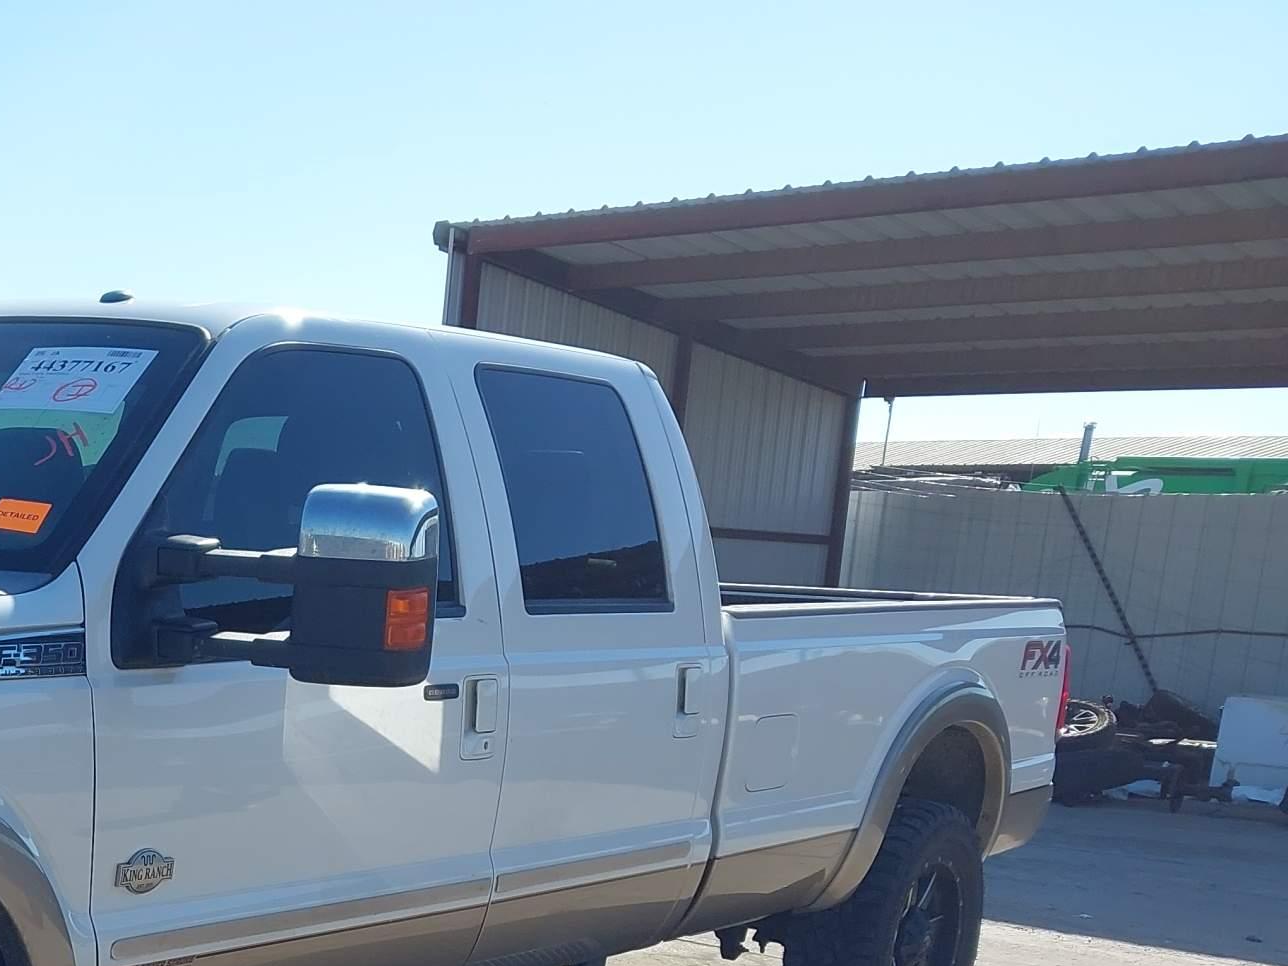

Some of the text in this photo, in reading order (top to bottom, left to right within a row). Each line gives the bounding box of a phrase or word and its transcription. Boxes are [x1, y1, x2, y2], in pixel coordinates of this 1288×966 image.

[31, 359, 133, 374] 44377167
[1020, 639, 1062, 671] FX4
[121, 861, 175, 883] KING RANCH
